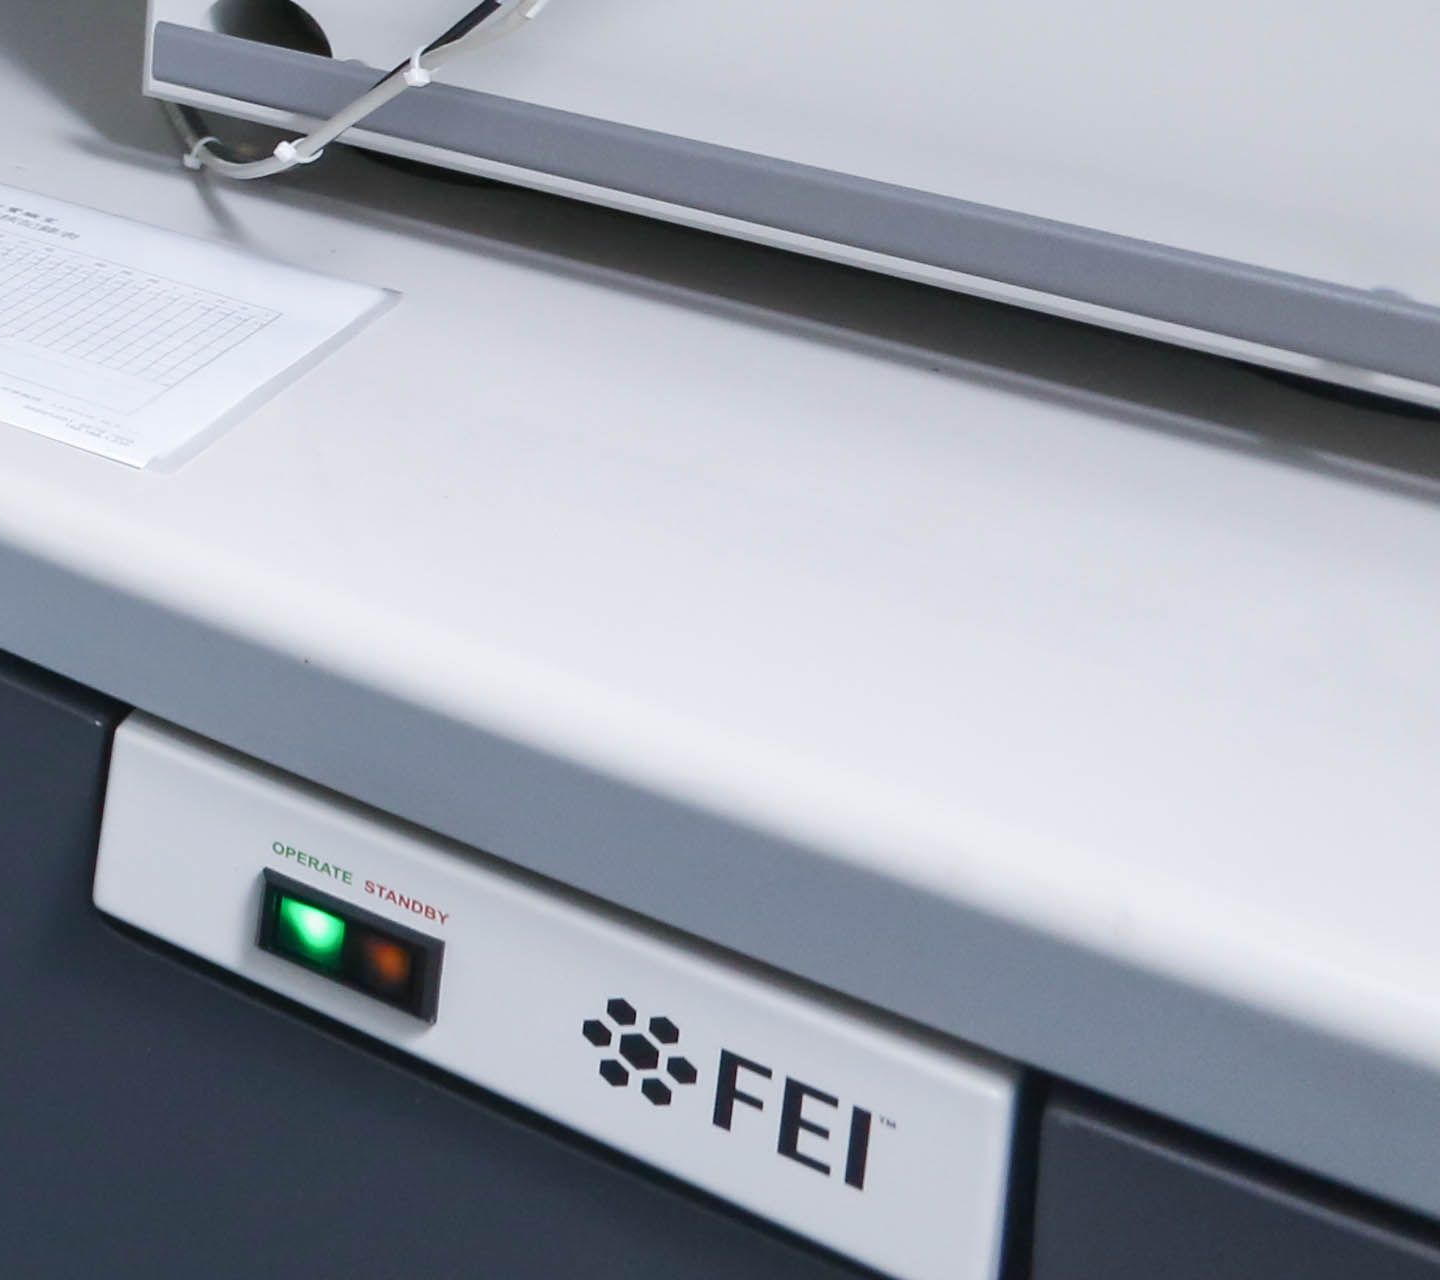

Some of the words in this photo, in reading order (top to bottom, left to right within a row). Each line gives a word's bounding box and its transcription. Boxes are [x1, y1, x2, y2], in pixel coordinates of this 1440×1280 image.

[272, 841, 353, 886] OPERATE
[364, 880, 450, 925] STANDBY
[712, 1047, 872, 1192] FEI
